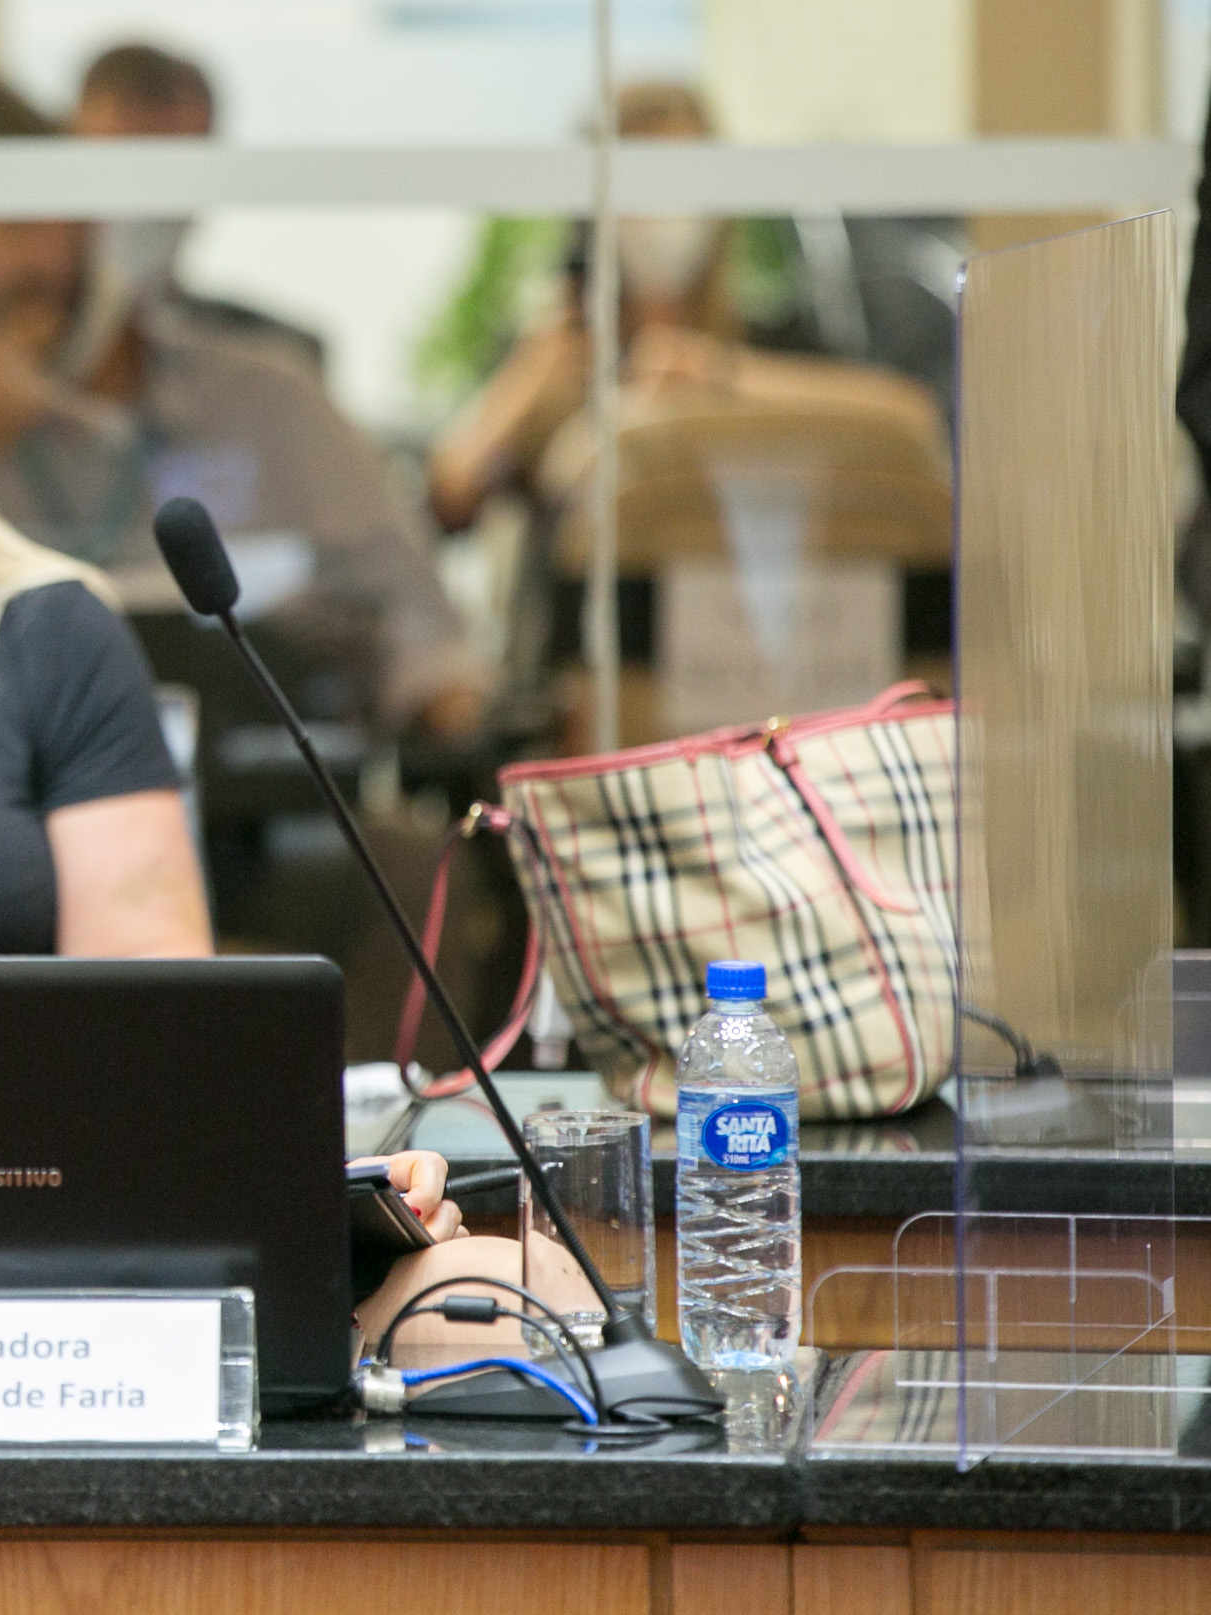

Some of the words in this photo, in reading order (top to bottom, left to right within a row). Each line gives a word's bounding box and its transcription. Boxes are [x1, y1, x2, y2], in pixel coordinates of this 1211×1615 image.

[716, 1116, 777, 1135] SANTA
[727, 1134, 771, 1153] RITA
[2, 1381, 45, 1408] de
[59, 1381, 146, 1408] Faria
